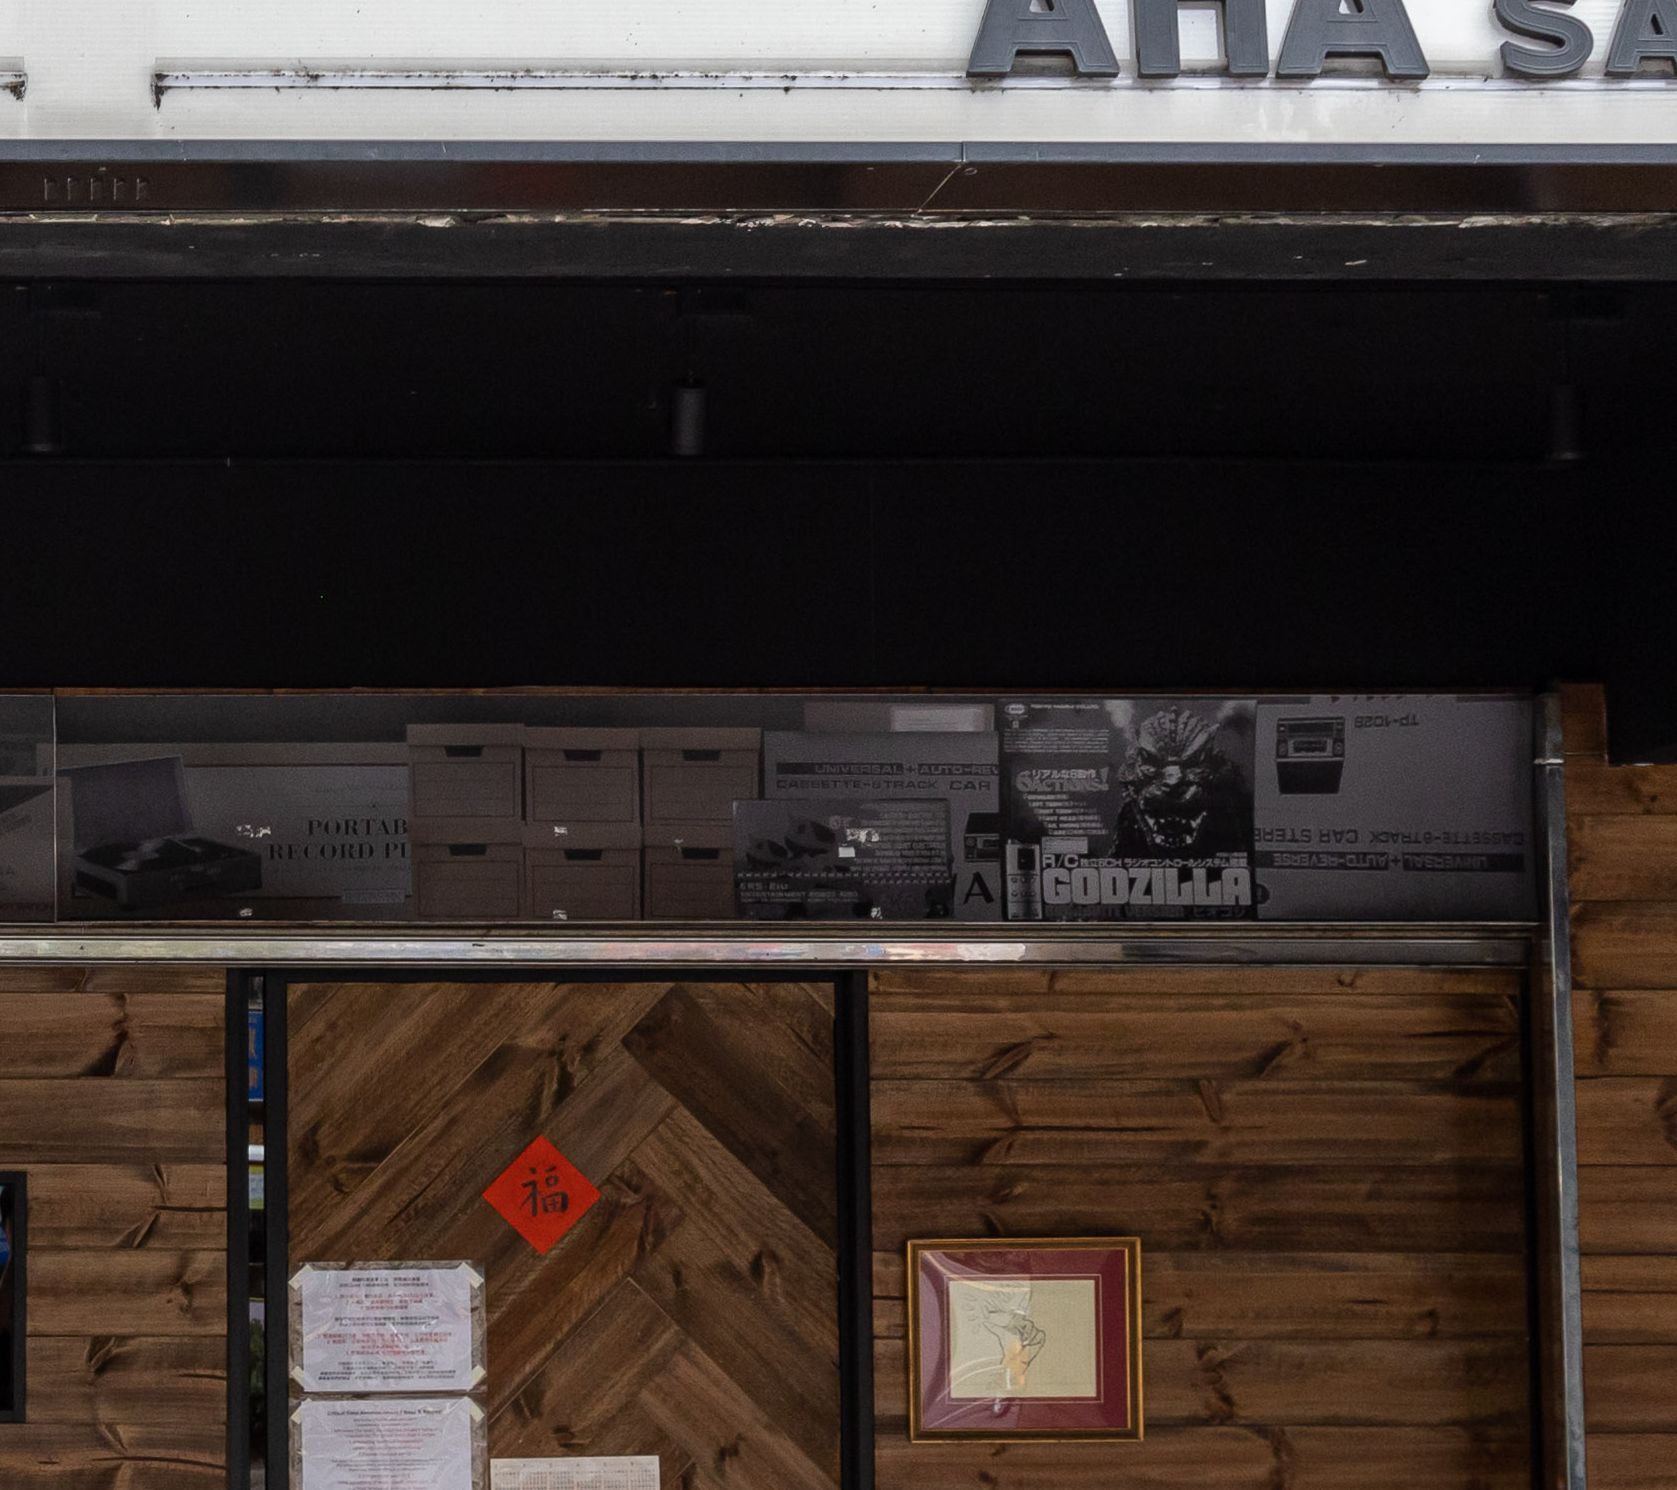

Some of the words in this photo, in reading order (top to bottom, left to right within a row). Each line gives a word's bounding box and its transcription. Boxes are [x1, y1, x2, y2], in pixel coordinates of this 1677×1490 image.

[815, 763, 902, 774] UNIVERSAL
[949, 780, 991, 791] CAR
[1319, 829, 1358, 844] CAR
[269, 843, 374, 859] RECORD
[1042, 854, 1079, 868] R/C
[1273, 853, 1388, 867] AUTO-REVERSE
[1404, 854, 1487, 868] UNIVERSAL
[1042, 868, 1252, 905] GODZILLA
[519, 1165, 568, 1218] 福
